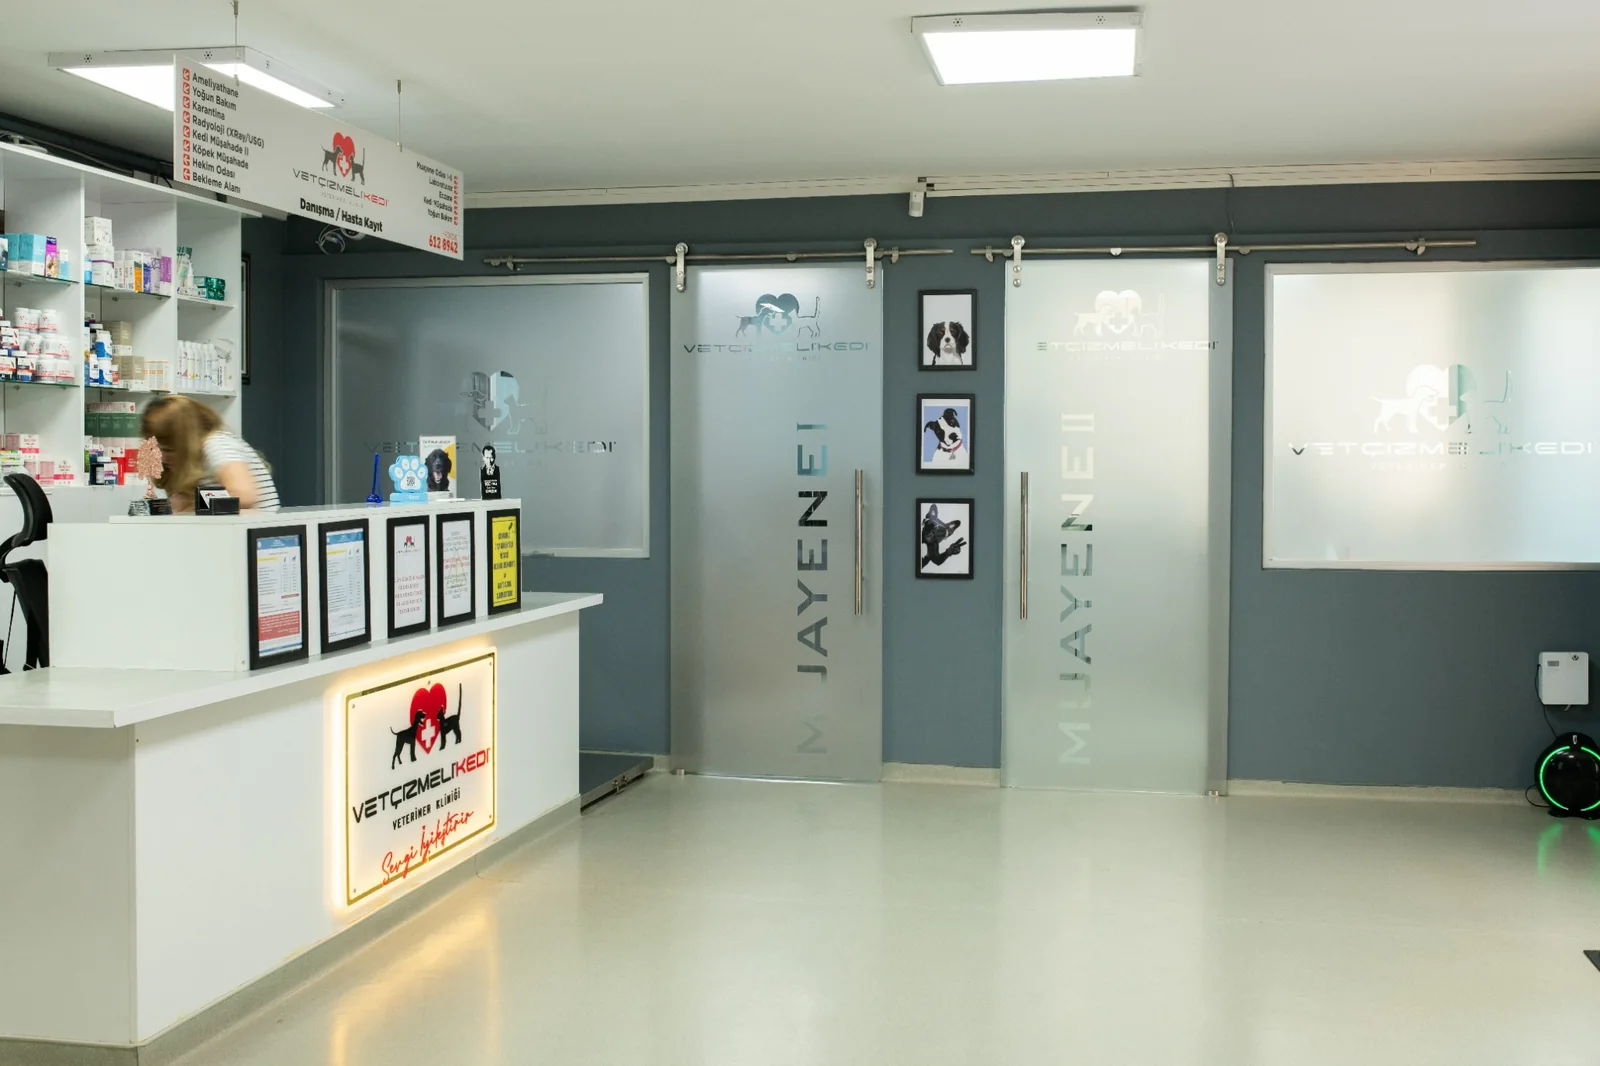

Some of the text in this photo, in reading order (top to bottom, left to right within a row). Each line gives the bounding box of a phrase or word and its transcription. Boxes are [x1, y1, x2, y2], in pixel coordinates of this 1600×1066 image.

[192, 73, 239, 98] Ameliyathane
[192, 86, 237, 111] Yoğun Bakım
[192, 100, 225, 120] Karantina
[192, 115, 225, 135] Radyoloji
[192, 129, 208, 142] Kedi
[192, 143, 215, 160] Köpek
[192, 158, 235, 179] Hekim Odası
[192, 172, 241, 193] Bekleme Alanı
[300, 197, 335, 218] Danışma
[341, 210, 363, 226] Hasta
[364, 217, 383, 232] Kayıt
[429, 235, 441, 250] 612
[442, 238, 458, 254] 8942
[392, 787, 460, 831] VETERİNER KLİNİĞİ
[382, 846, 418, 885] Sevgi
